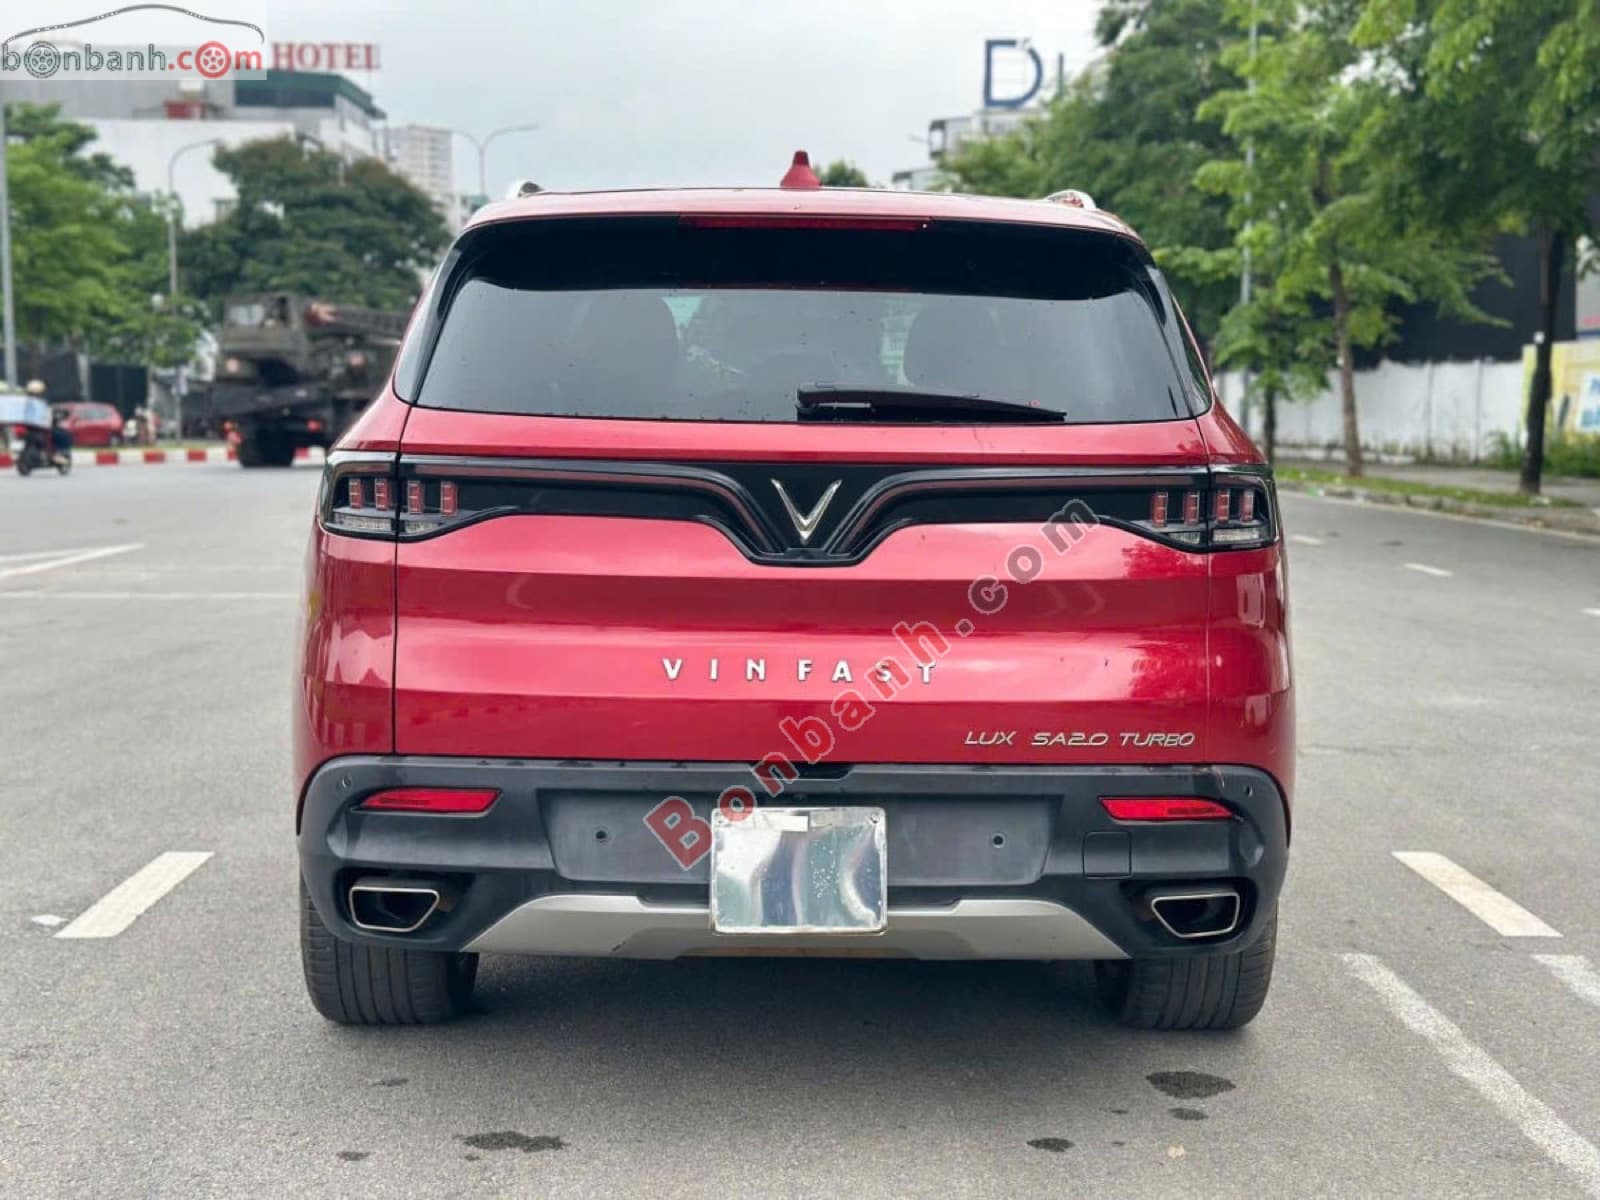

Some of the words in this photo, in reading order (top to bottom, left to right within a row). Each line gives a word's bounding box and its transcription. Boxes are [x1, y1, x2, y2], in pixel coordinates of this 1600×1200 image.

[272, 42, 381, 71] HOTEL
[662, 658, 936, 683] VINFAST
[964, 731, 1016, 745] LUX
[1120, 732, 1195, 746] TURBO
